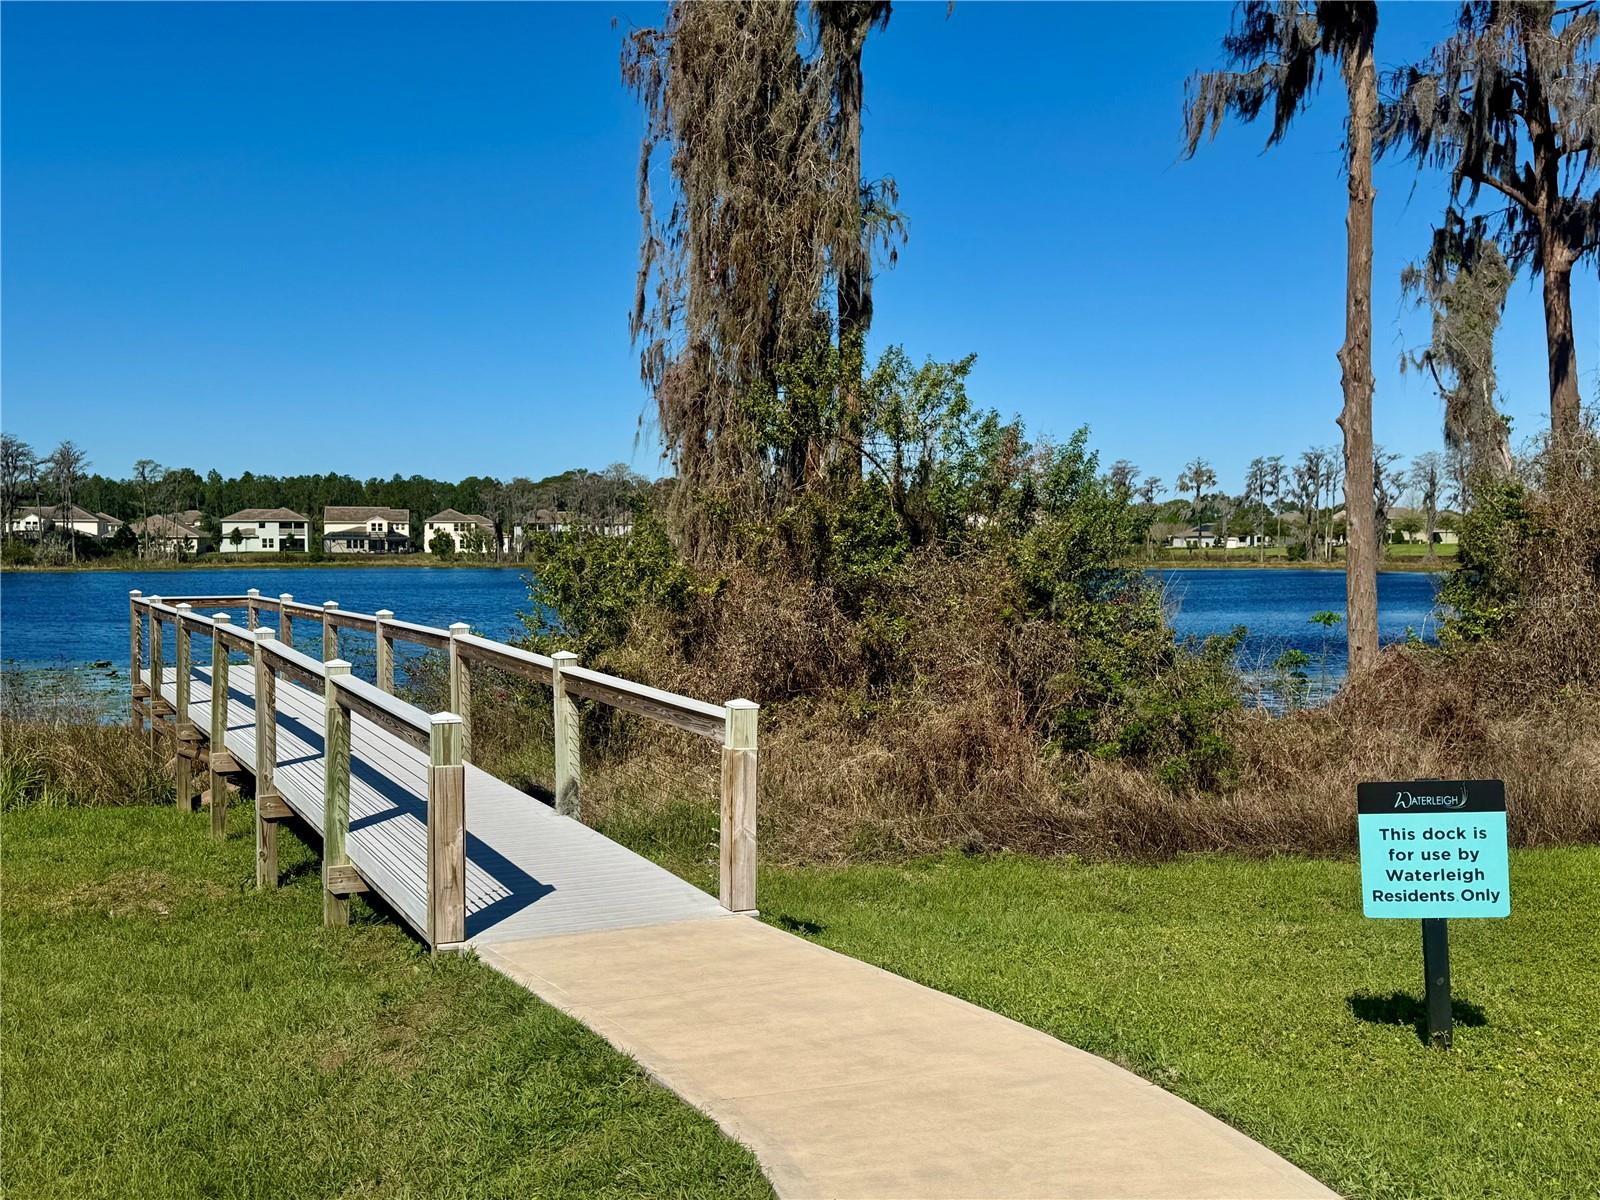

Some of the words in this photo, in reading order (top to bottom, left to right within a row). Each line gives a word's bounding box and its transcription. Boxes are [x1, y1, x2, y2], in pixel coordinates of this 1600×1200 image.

[1394, 791, 1458, 808] WATERLEIGH
[1379, 828, 1416, 841] This
[1422, 827, 1466, 840] dock
[1473, 826, 1487, 839] is
[1388, 848, 1414, 861] for
[1421, 850, 1451, 861] use
[1458, 848, 1479, 862] by
[1386, 868, 1485, 883] Waterleigh
[1372, 889, 1455, 902] Residents
[1461, 888, 1500, 903] Only
